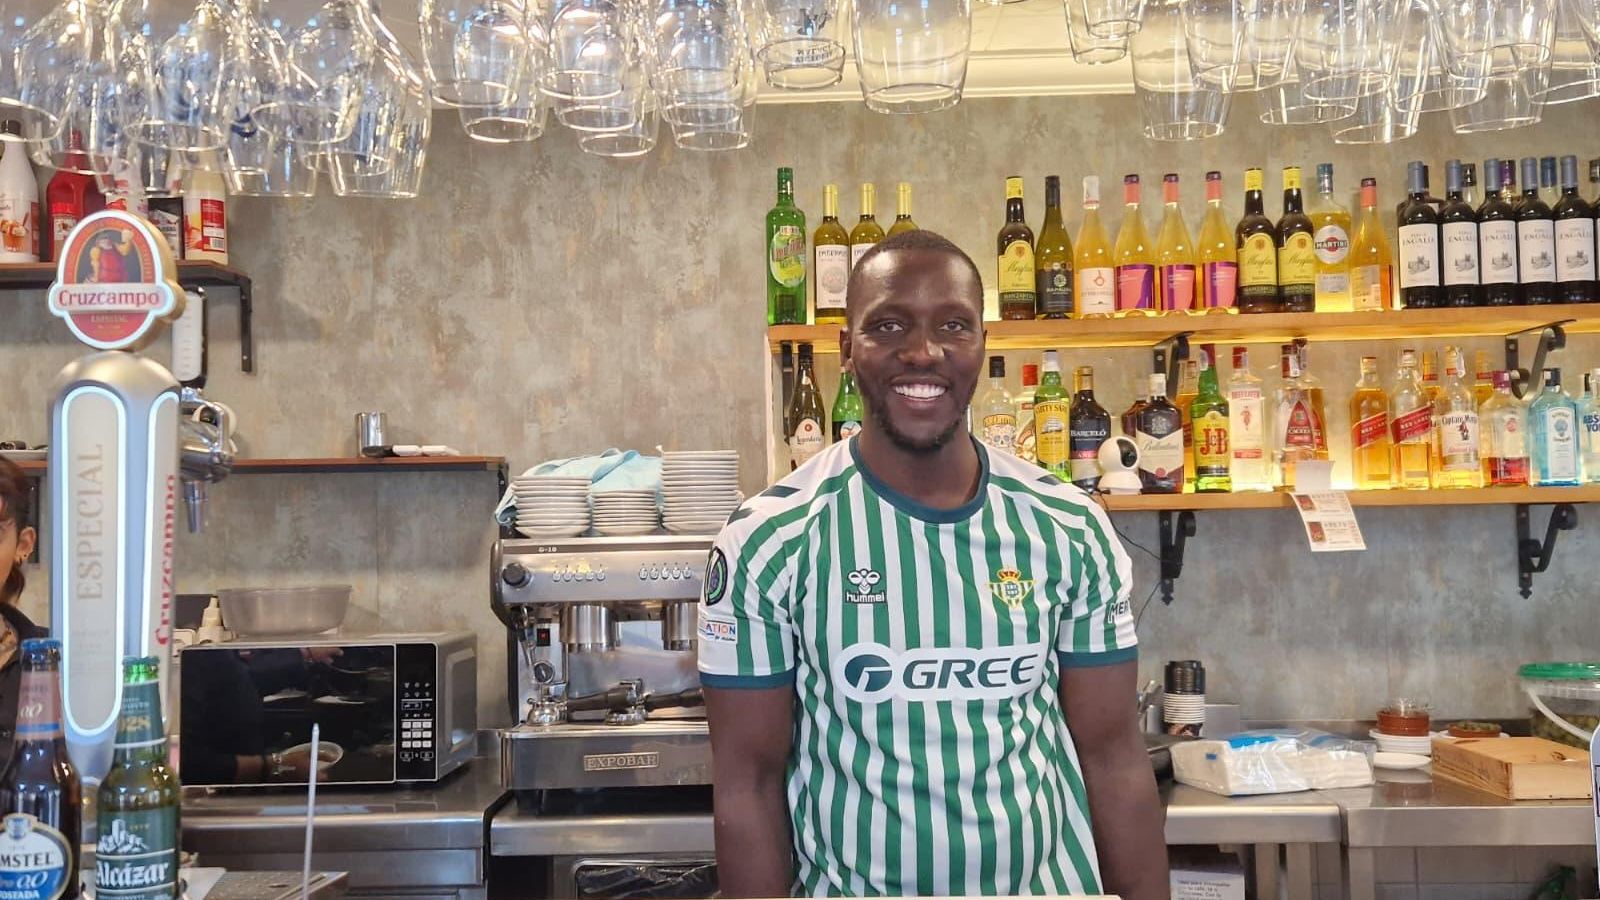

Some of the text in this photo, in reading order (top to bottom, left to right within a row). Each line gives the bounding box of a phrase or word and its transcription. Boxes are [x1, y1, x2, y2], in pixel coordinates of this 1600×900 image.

[1314, 240, 1348, 250] MARTINI
[59, 289, 160, 309] Cruzcampo
[1070, 428, 1107, 437] BARCELÓ
[76, 443, 103, 600] ESPECIAL
[155, 474, 176, 645] Cruzcampo
[846, 591, 885, 603] hummel
[902, 653, 1039, 690] GREE
[587, 755, 657, 769] EXPOBAR
[0, 852, 54, 868] MSTEL
[95, 860, 170, 888] Alcázar
